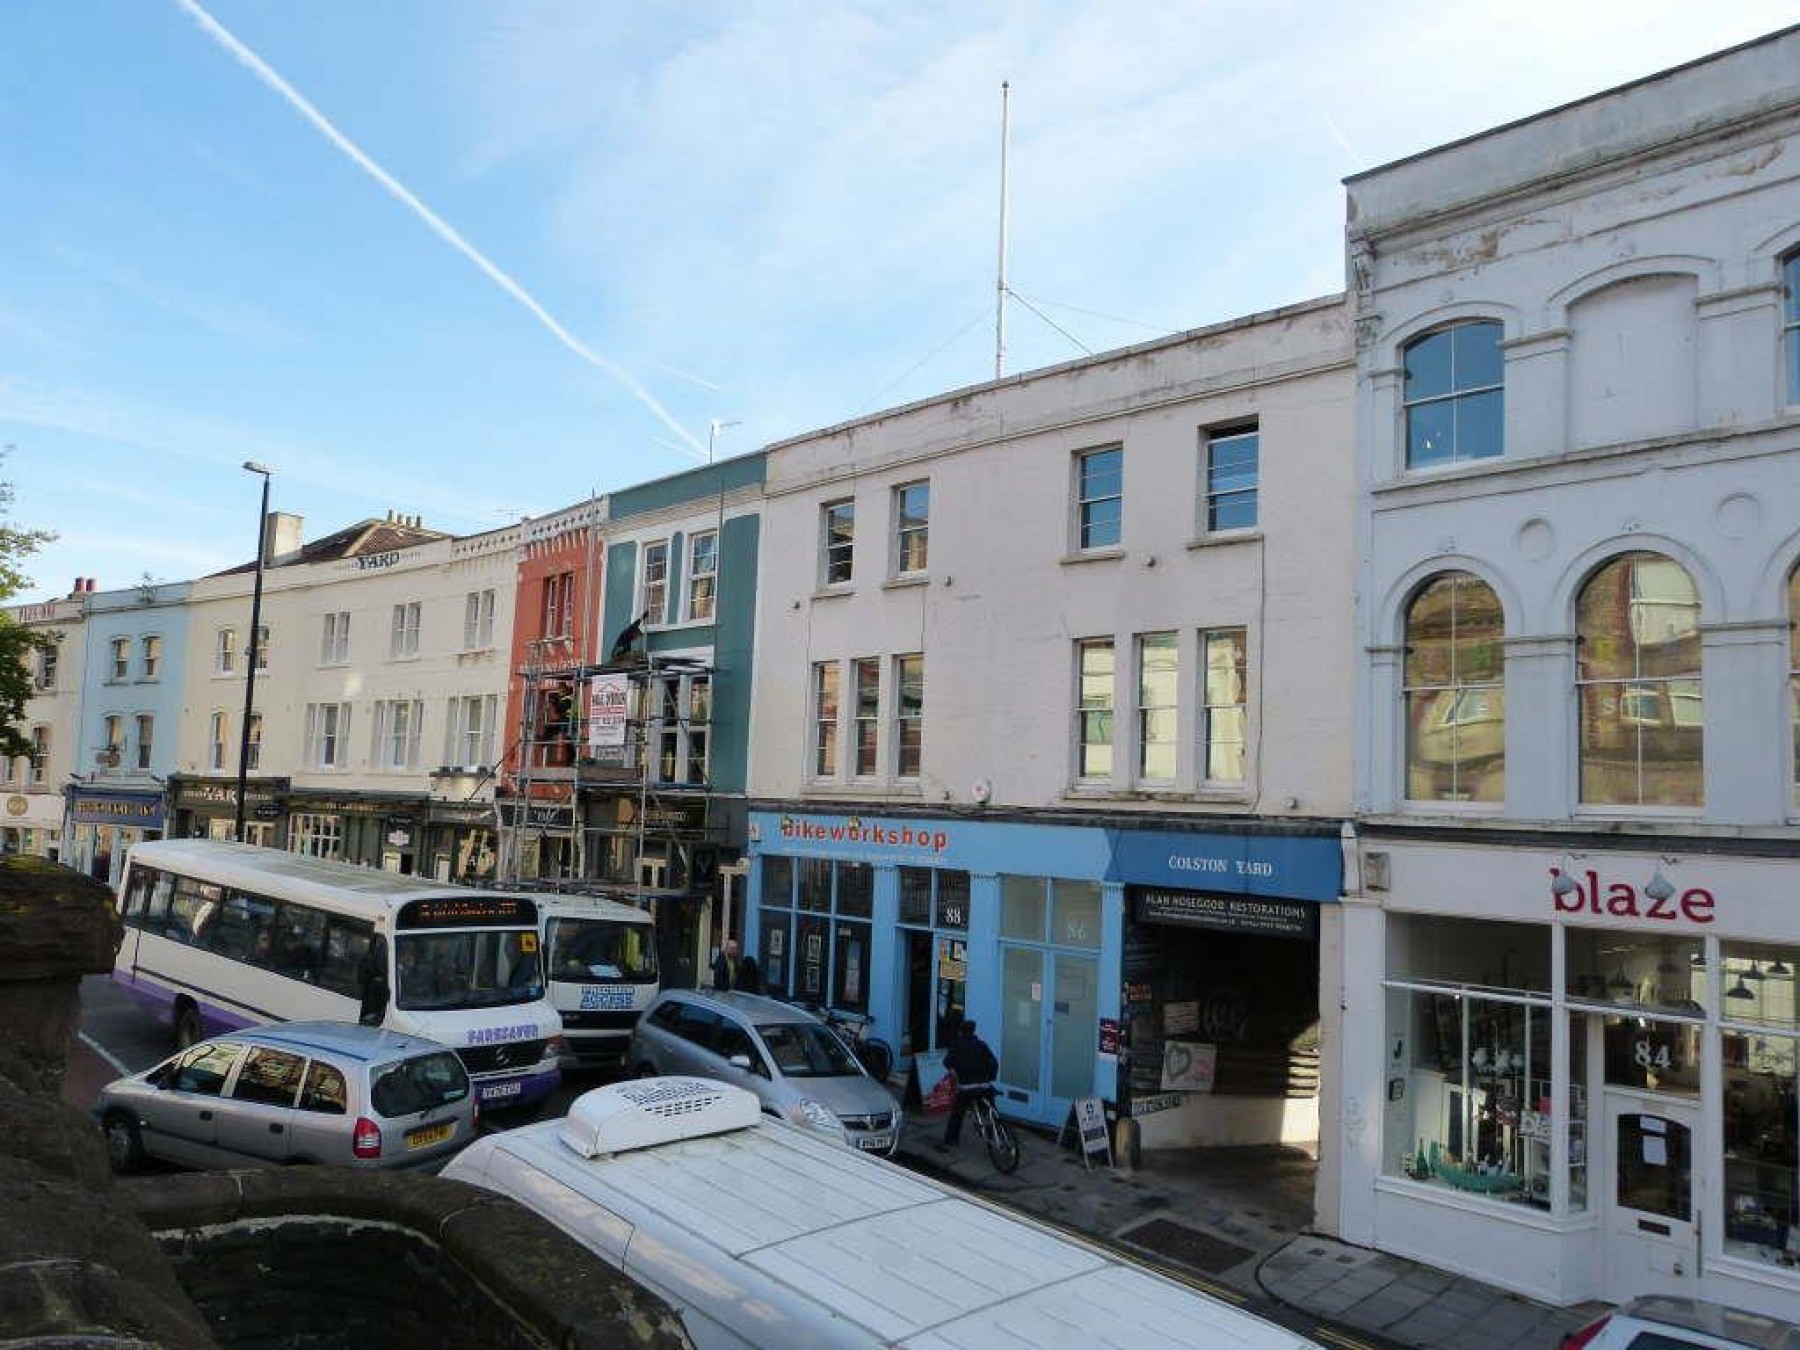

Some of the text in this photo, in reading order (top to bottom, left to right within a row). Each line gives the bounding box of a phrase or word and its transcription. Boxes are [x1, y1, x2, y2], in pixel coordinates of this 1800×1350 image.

[358, 552, 400, 570] YARD
[1168, 855, 1273, 877] COLSTON YARD
[1145, 893, 1170, 906] ALAN
[1229, 899, 1306, 919] RESTORATIONS
[1549, 867, 1715, 923] blaze
[945, 907, 962, 924] 88
[1634, 1040, 1673, 1070] 84
